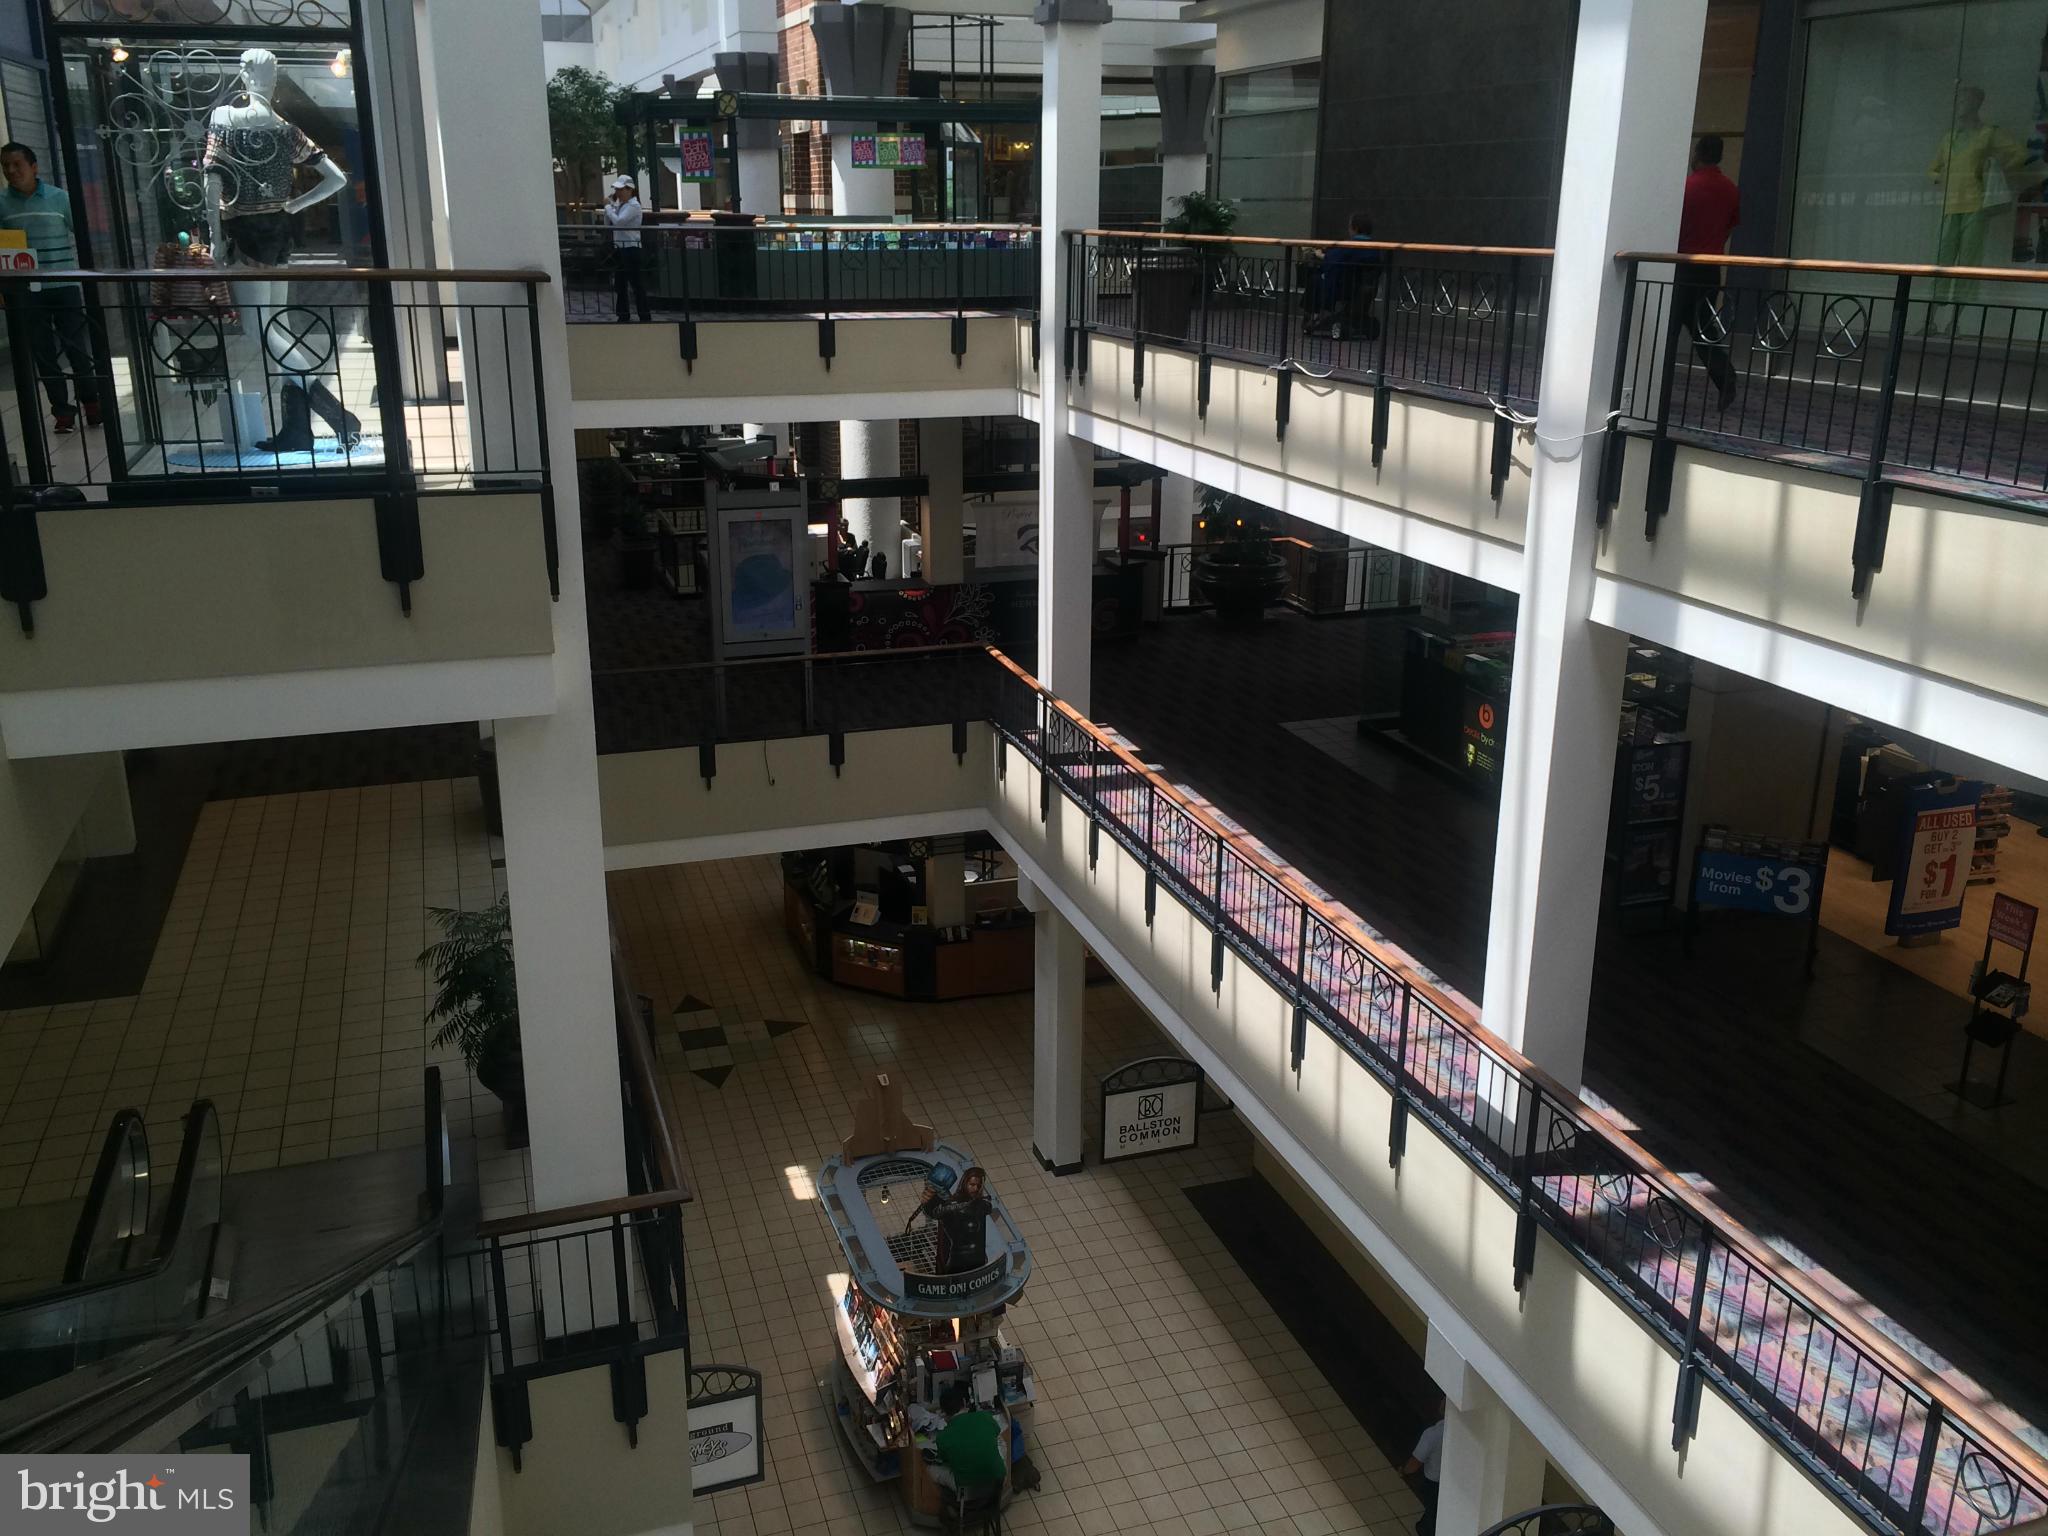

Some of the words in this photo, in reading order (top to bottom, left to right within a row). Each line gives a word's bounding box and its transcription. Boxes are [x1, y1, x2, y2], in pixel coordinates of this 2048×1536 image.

[1919, 814, 1940, 831] ALL
[1942, 812, 1973, 828] USED
[1930, 830, 1950, 842] BUY
[1951, 829, 1959, 840] 2
[1924, 842, 1942, 854] GET
[1701, 866, 1752, 884] Movies
[1923, 854, 1957, 897] $1
[1708, 880, 1741, 895] from
[1755, 865, 1811, 914] $3
[1119, 1116, 1181, 1134] BALLSTON
[1119, 1125, 1181, 1144] COMMON
[918, 1283, 947, 1295] GAME
[949, 1282, 967, 1294] ON!
[969, 1268, 1000, 1290] COMICS
